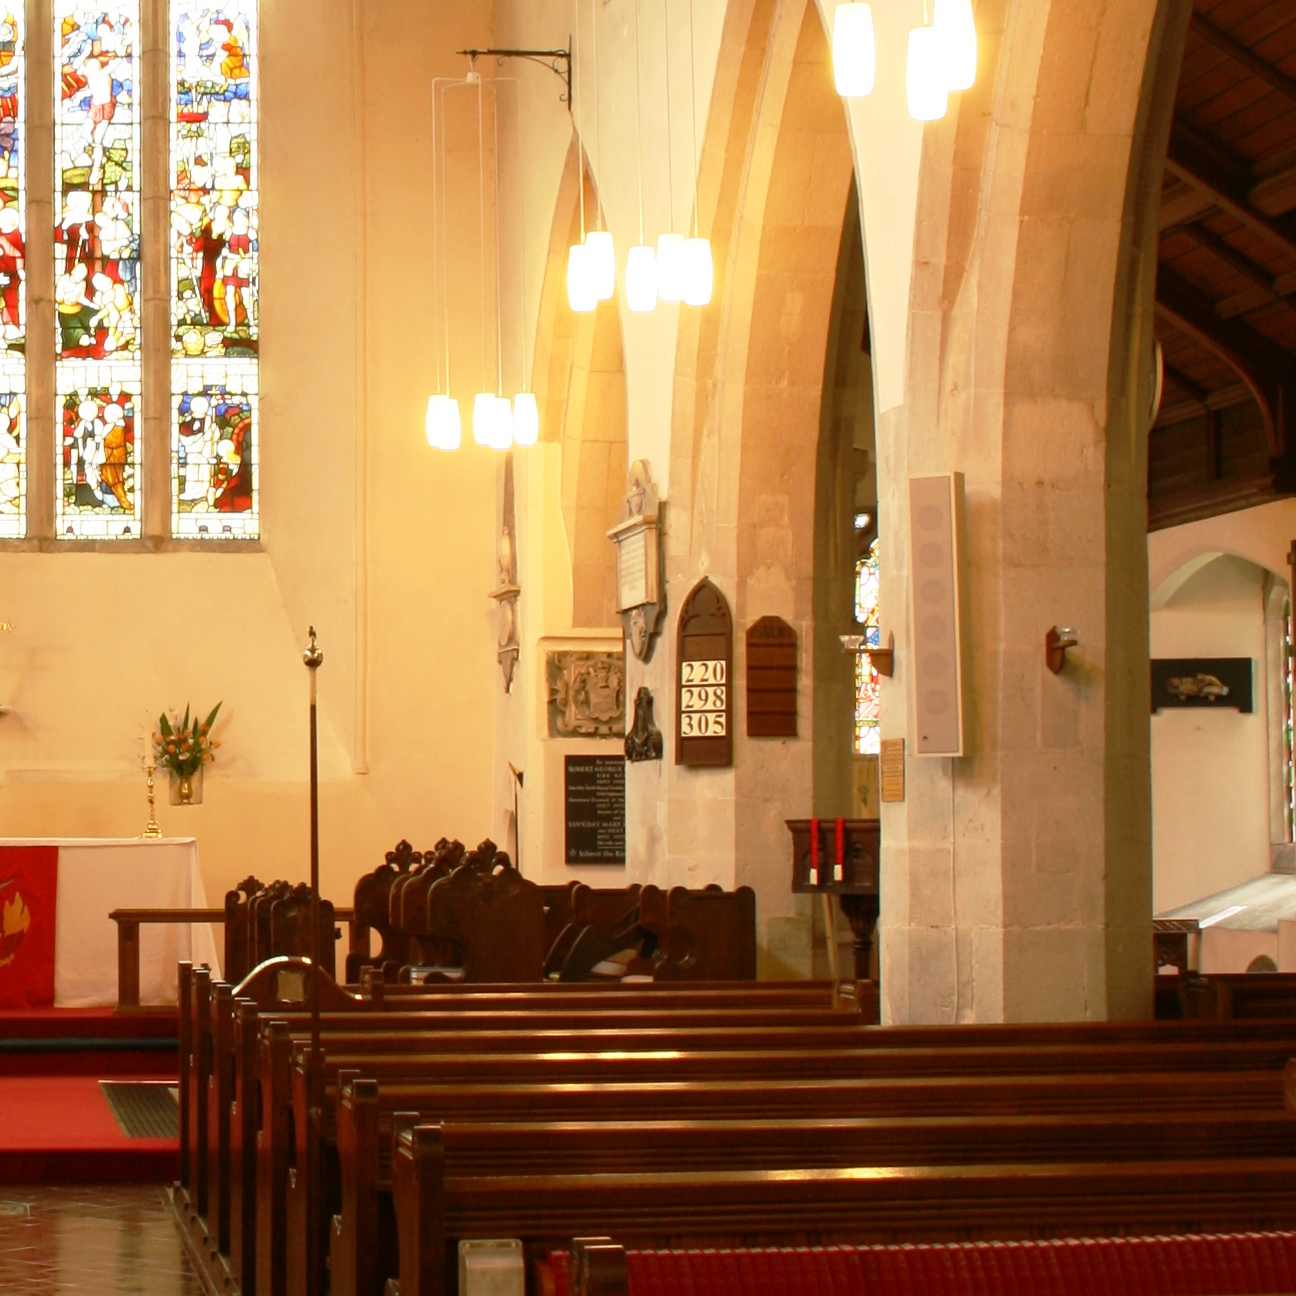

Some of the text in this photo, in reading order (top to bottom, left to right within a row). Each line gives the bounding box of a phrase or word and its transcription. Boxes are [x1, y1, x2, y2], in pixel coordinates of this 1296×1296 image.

[684, 661, 724, 682] 220
[684, 687, 724, 709] 298
[683, 712, 724, 735] 305
